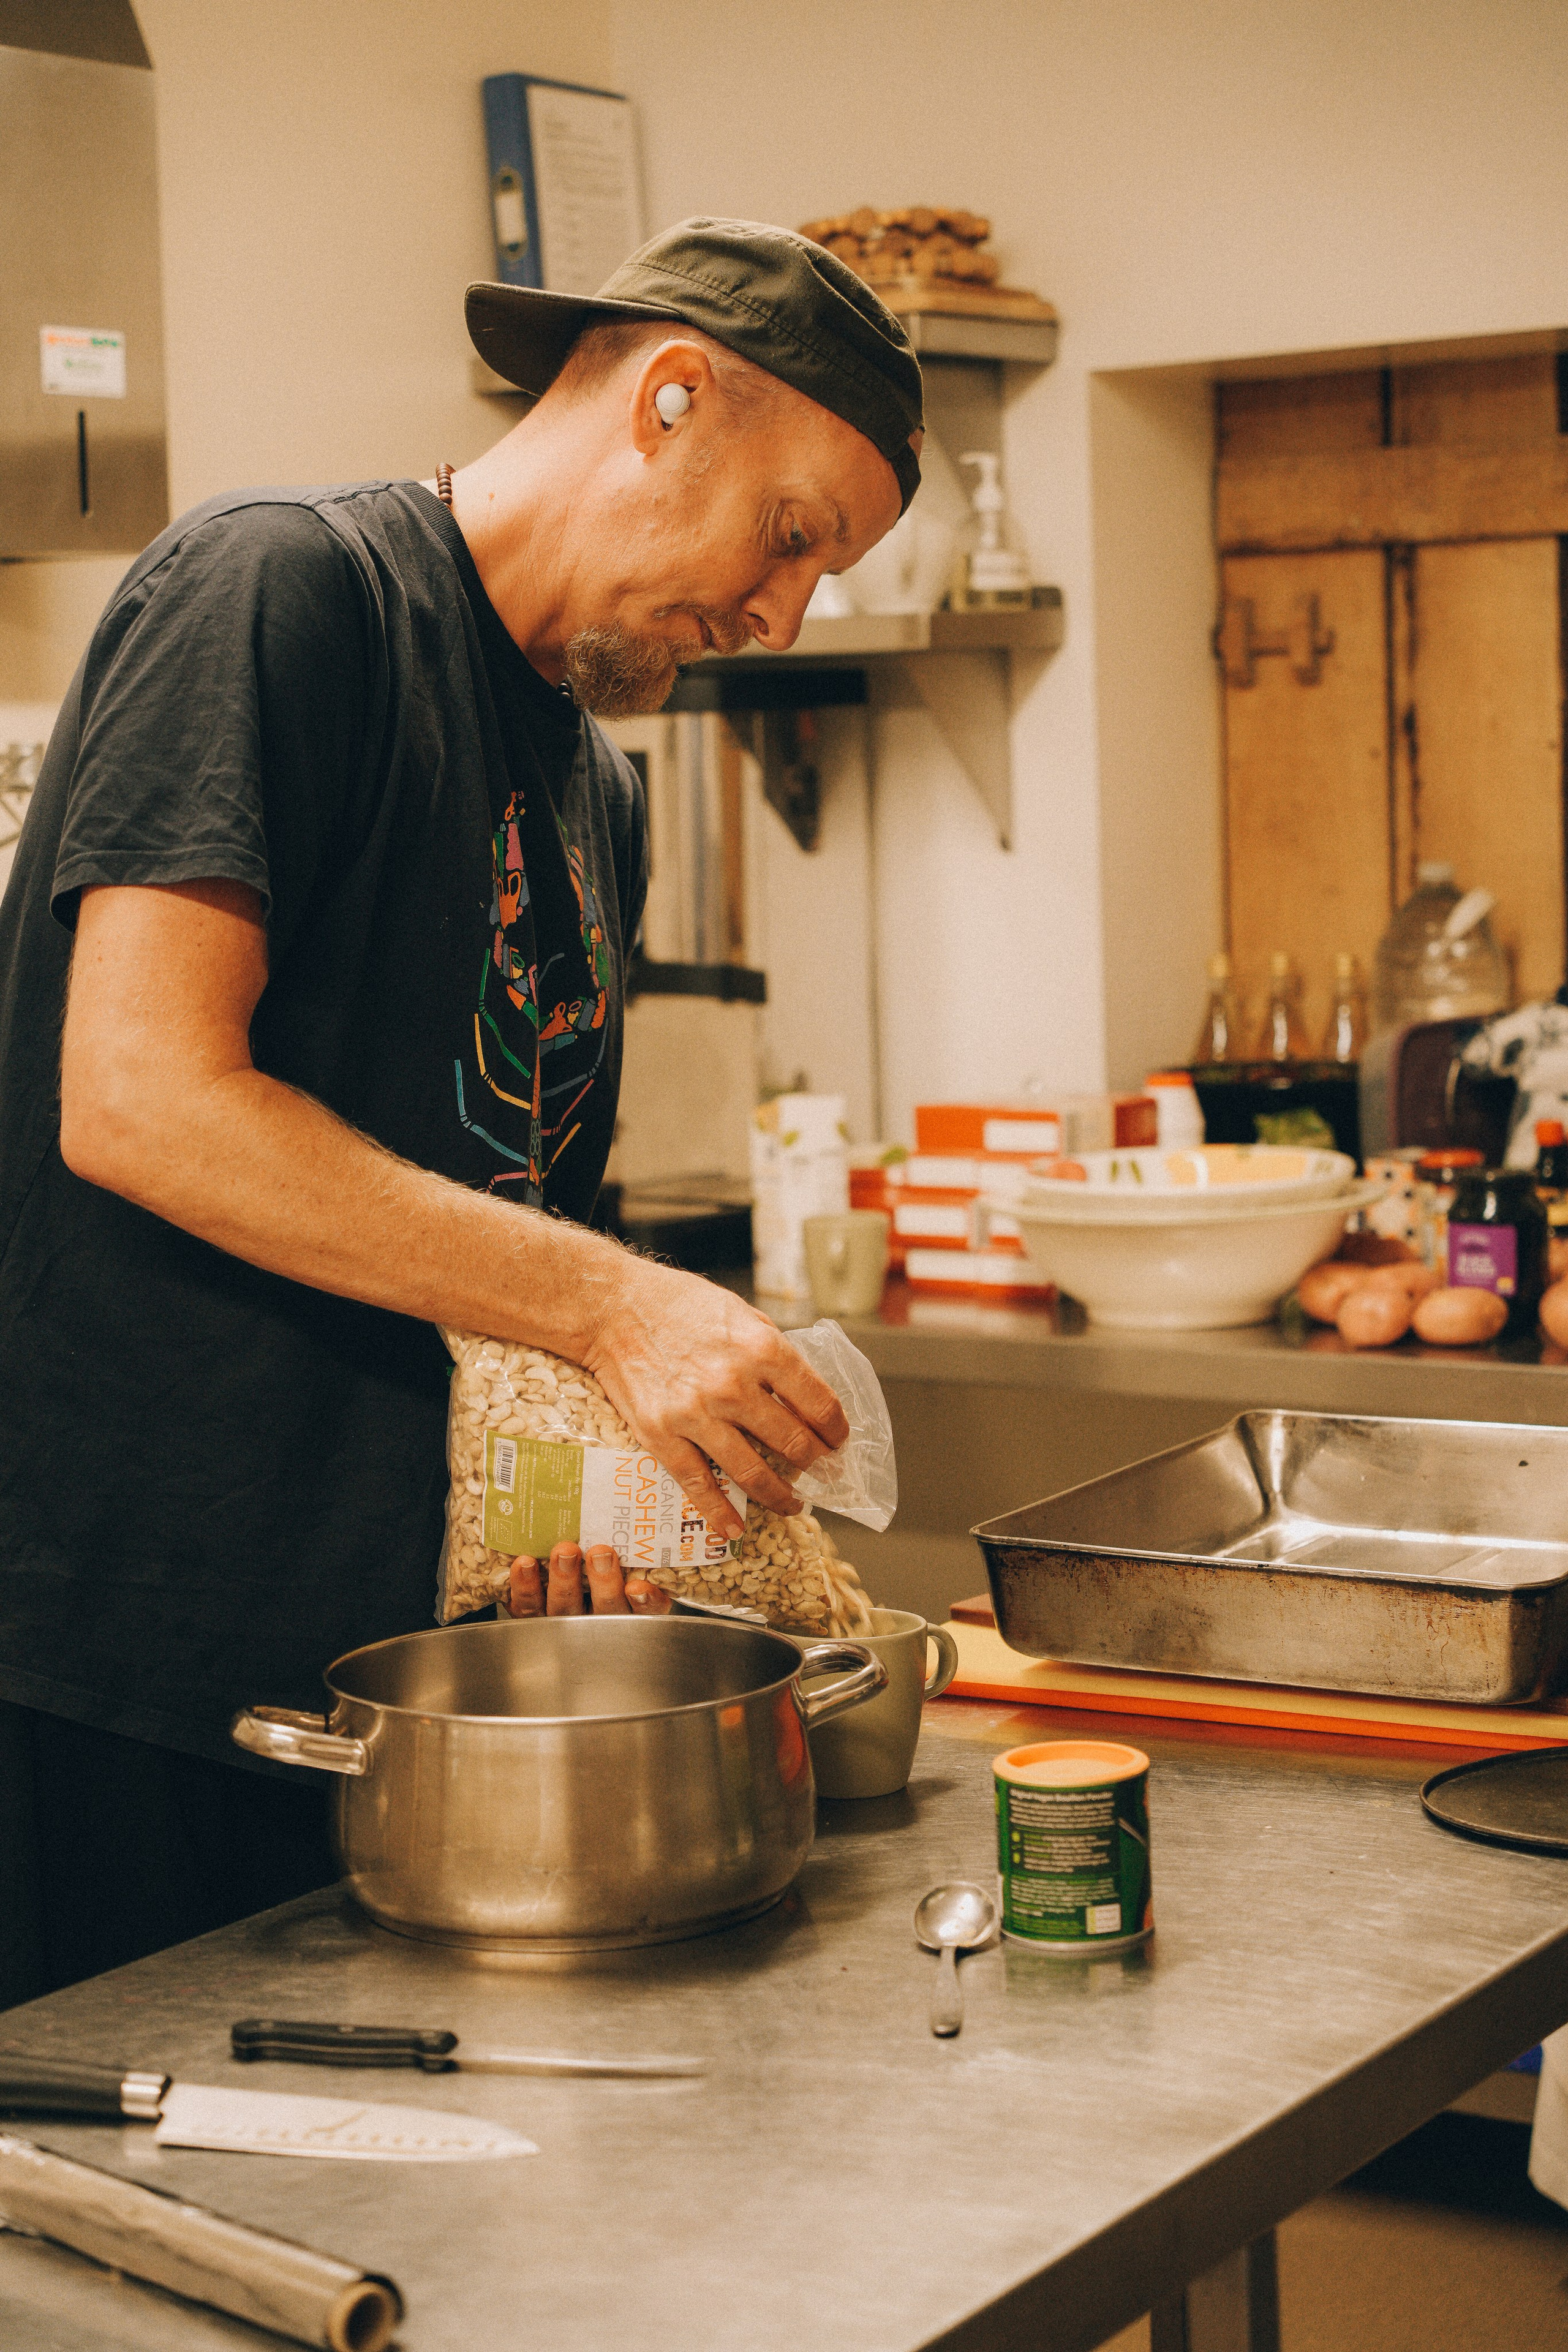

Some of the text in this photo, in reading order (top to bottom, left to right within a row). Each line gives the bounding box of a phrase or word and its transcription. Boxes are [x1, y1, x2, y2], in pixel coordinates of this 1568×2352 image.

[612, 1457, 633, 1563] NUT PIECES
[633, 1456, 657, 1563] CASHEW
[660, 1468, 674, 1534] RGANIC
